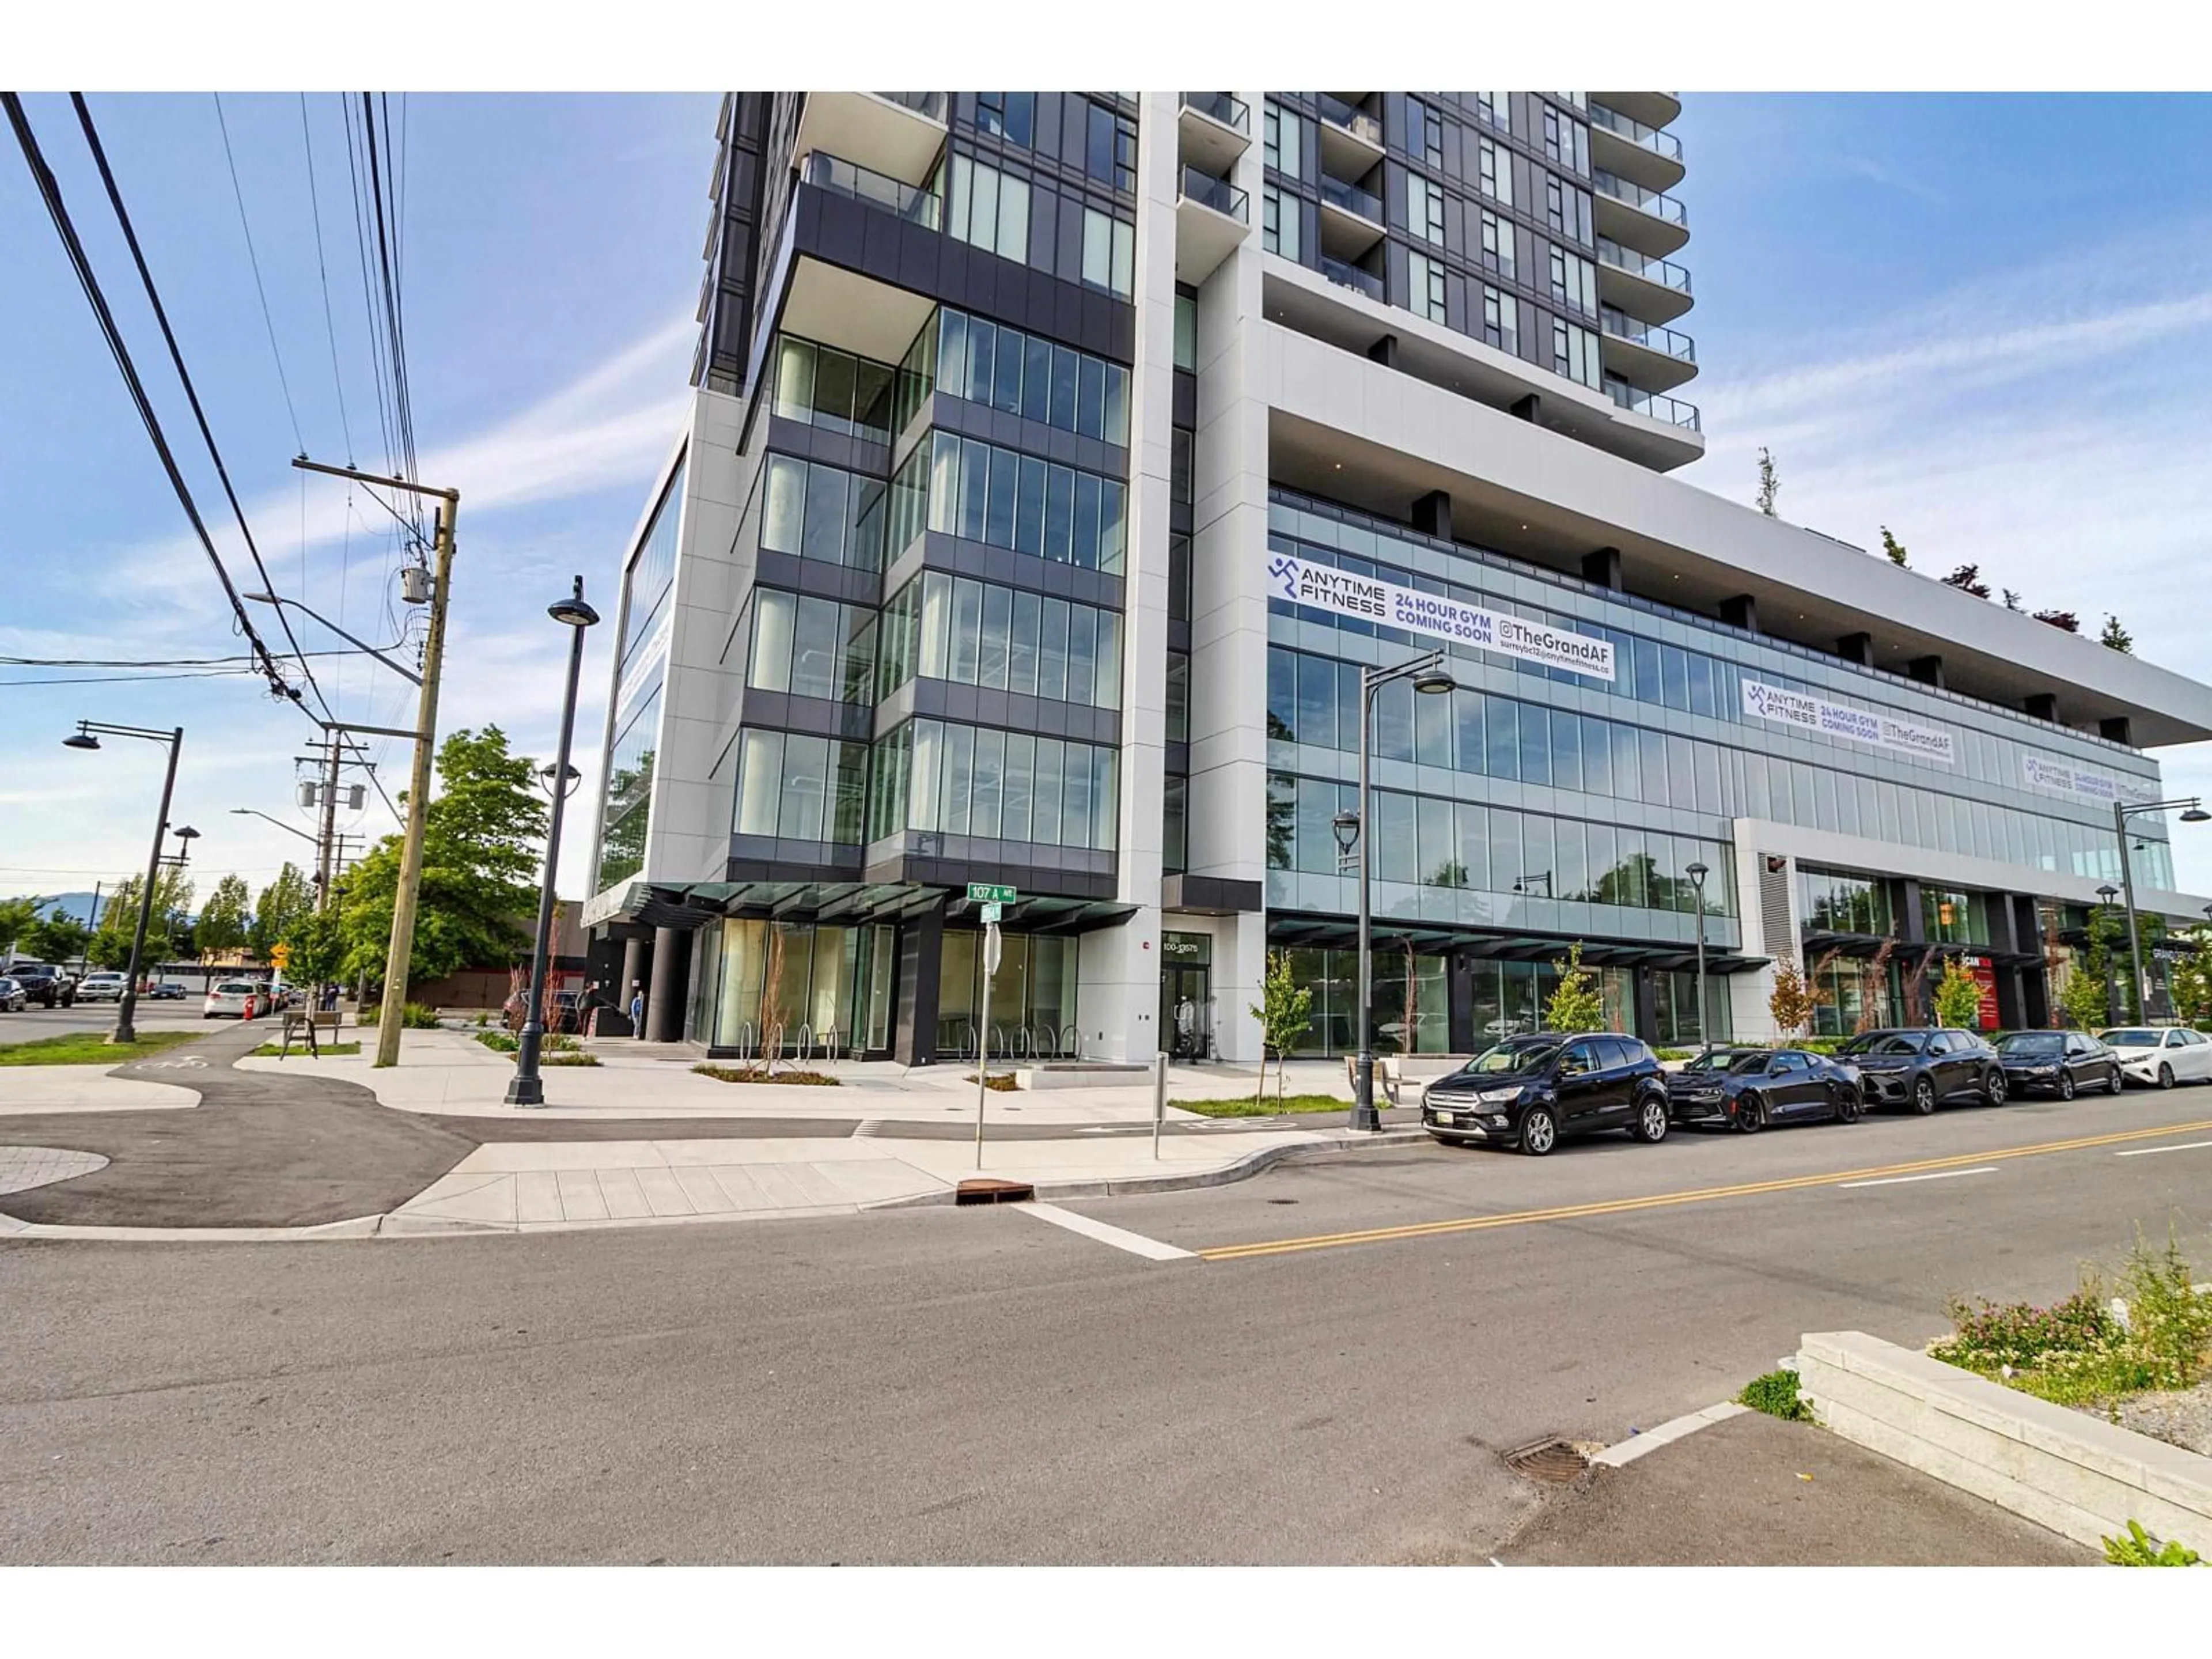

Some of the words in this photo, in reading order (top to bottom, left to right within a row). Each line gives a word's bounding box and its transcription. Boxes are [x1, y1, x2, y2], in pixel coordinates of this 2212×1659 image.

[1301, 568, 1385, 601] ANYTIME
[1301, 584, 1385, 616] FITNESS
[1395, 593, 1414, 609] 24
[1415, 598, 1457, 620] HOUR
[1460, 609, 1491, 629] GYM
[1396, 609, 1452, 633] COMING
[1455, 623, 1492, 643] SOON
[1767, 691, 1815, 713] ANYTIME
[1767, 703, 1816, 725] FITNESS
[1832, 708, 1858, 725] HOUR
[1858, 715, 1878, 729] GYM
[972, 886, 991, 899] 107
[993, 888, 999, 901] A
